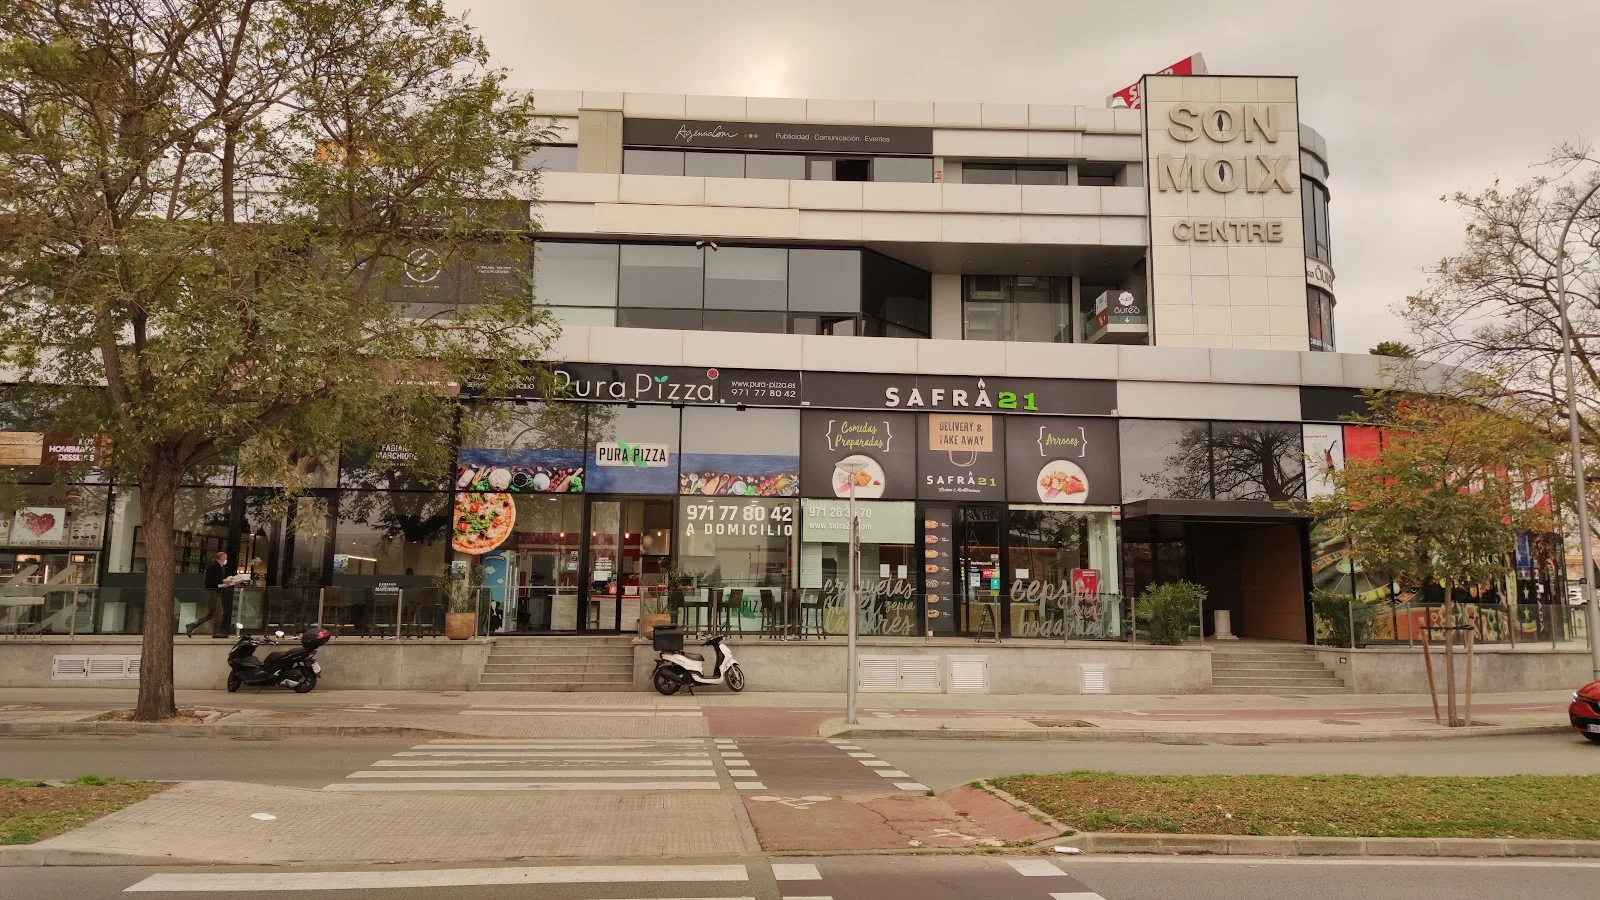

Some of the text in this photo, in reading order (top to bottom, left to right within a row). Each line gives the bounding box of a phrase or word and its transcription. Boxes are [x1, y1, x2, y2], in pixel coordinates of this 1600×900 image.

[1168, 102, 1279, 143] SON
[775, 132, 890, 143] Publicidad. Comunicación. Eventos
[1157, 152, 1294, 194] MOIX
[1172, 219, 1284, 243] CENTRE
[553, 370, 626, 398] Pura
[635, 373, 714, 401] Pizza
[731, 380, 796, 390] www.pura-pizza.es
[731, 388, 750, 396] 971
[769, 389, 782, 397] 80
[783, 389, 796, 398] 42
[841, 421, 877, 434] Comidas
[939, 421, 983, 432] DELIVERY &
[835, 434, 884, 449] Preparadas
[939, 435, 984, 446] TAKE AWAY
[1045, 433, 1079, 446] Arroces
[599, 447, 666, 463] PURA PIZZA
[687, 505, 792, 521] 971 77 80 42
[809, 507, 827, 517] 971
[830, 507, 842, 518] 26
[860, 507, 872, 518] 70
[685, 522, 793, 536] A DOMICILIO
